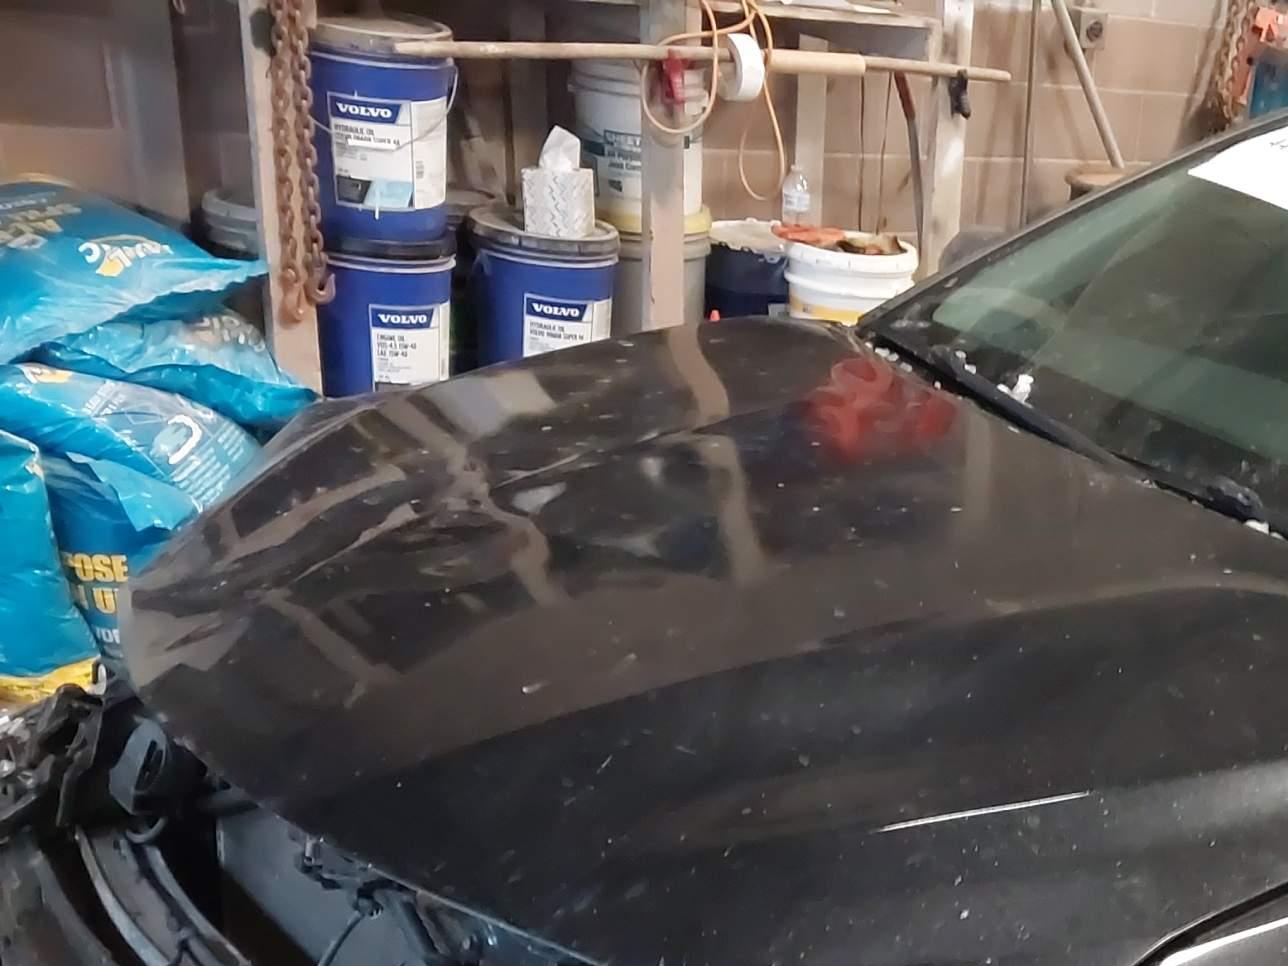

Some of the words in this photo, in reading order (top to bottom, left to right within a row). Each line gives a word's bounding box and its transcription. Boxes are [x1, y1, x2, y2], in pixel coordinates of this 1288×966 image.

[336, 102, 393, 119] VOLVO
[531, 302, 580, 318] VOLVO
[377, 313, 428, 325] VOLVO
